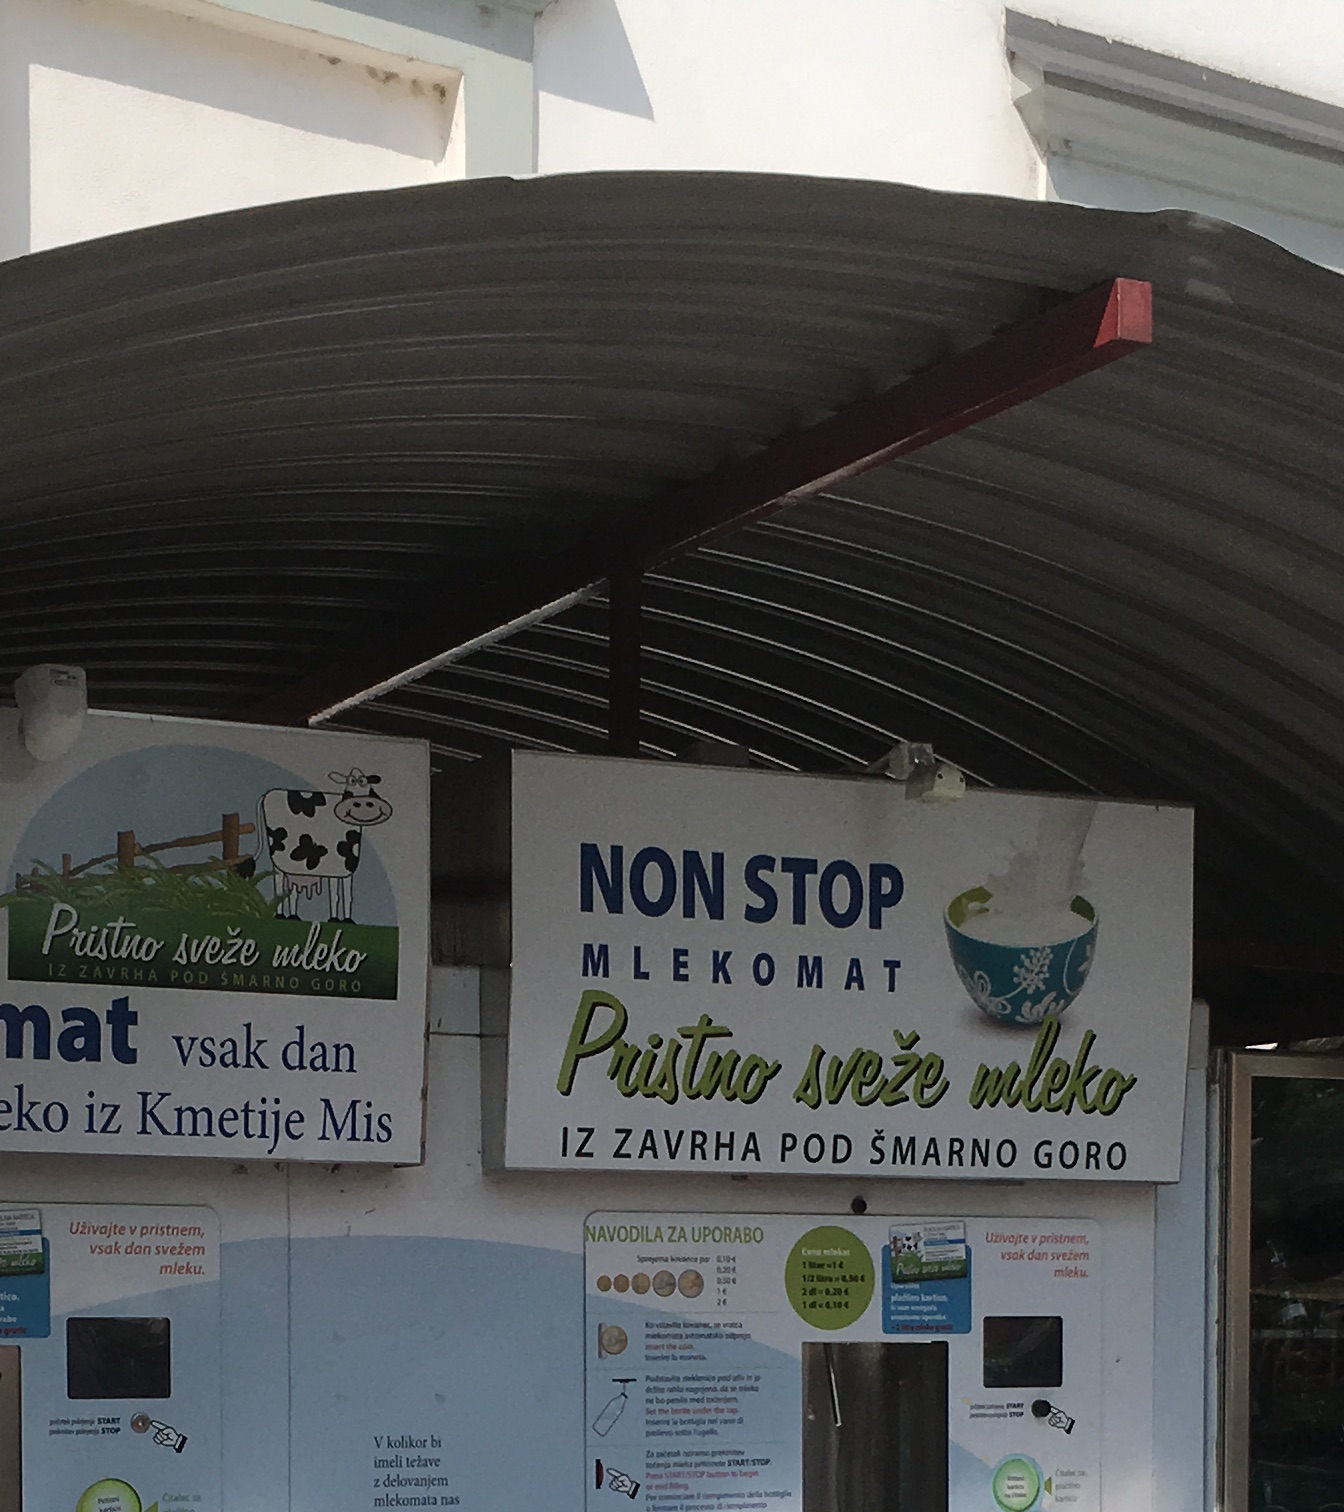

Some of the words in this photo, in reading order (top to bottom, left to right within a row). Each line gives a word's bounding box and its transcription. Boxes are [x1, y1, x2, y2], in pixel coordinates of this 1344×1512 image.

[578, 841, 726, 922] NON
[743, 853, 905, 931] STOP
[41, 902, 164, 965] Pristno
[173, 928, 259, 969] sveže
[269, 920, 368, 975] mleko
[48, 962, 69, 978] IZ
[79, 964, 160, 984] ZAVRHA
[170, 967, 209, 986] POD
[219, 969, 301, 990] ŠMARNO
[311, 975, 364, 993] GORO
[581, 942, 902, 994] MLEKOMAT
[172, 1022, 270, 1073] vsak
[281, 1024, 358, 1076] dan
[556, 989, 782, 1102] Pristno
[795, 1026, 951, 1109] sveže
[968, 1014, 1137, 1118] mleko
[85, 1091, 122, 1136] iz
[137, 1090, 306, 1155] Kmetije
[317, 1099, 394, 1146] Mis
[560, 1126, 595, 1159] IZ
[612, 1127, 762, 1163] ZAVRHA
[779, 1131, 854, 1165] POD
[869, 1126, 1018, 1169] ŠMARNO
[1033, 1139, 1128, 1171] GORO
[69, 1219, 125, 1236] Uživajte
[128, 1224, 137, 1236] v
[140, 1222, 205, 1239] pristnem,
[585, 1225, 664, 1243] NAVODILA
[668, 1226, 687, 1243] ZA
[691, 1226, 764, 1244] UPORABO
[89, 1241, 121, 1255] vsak
[124, 1241, 152, 1256] dan
[155, 1240, 205, 1256] svežem
[1031, 1234, 1038, 1245] v
[1038, 1233, 1089, 1246] pristnem,
[1001, 1250, 1026, 1261] vsak
[1029, 1250, 1049, 1262] dan
[159, 1261, 205, 1275] mleku.
[1054, 1267, 1089, 1278] mleku.
[373, 1435, 384, 1449] V
[387, 1435, 427, 1450] kolikor
[431, 1435, 442, 1448] bi
[374, 1455, 402, 1468] imeli
[405, 1455, 441, 1468] težave
[374, 1477, 380, 1487] z
[383, 1474, 448, 1491] delovanjem
[374, 1494, 437, 1507] mlekomata
[440, 1494, 460, 1506] nas
